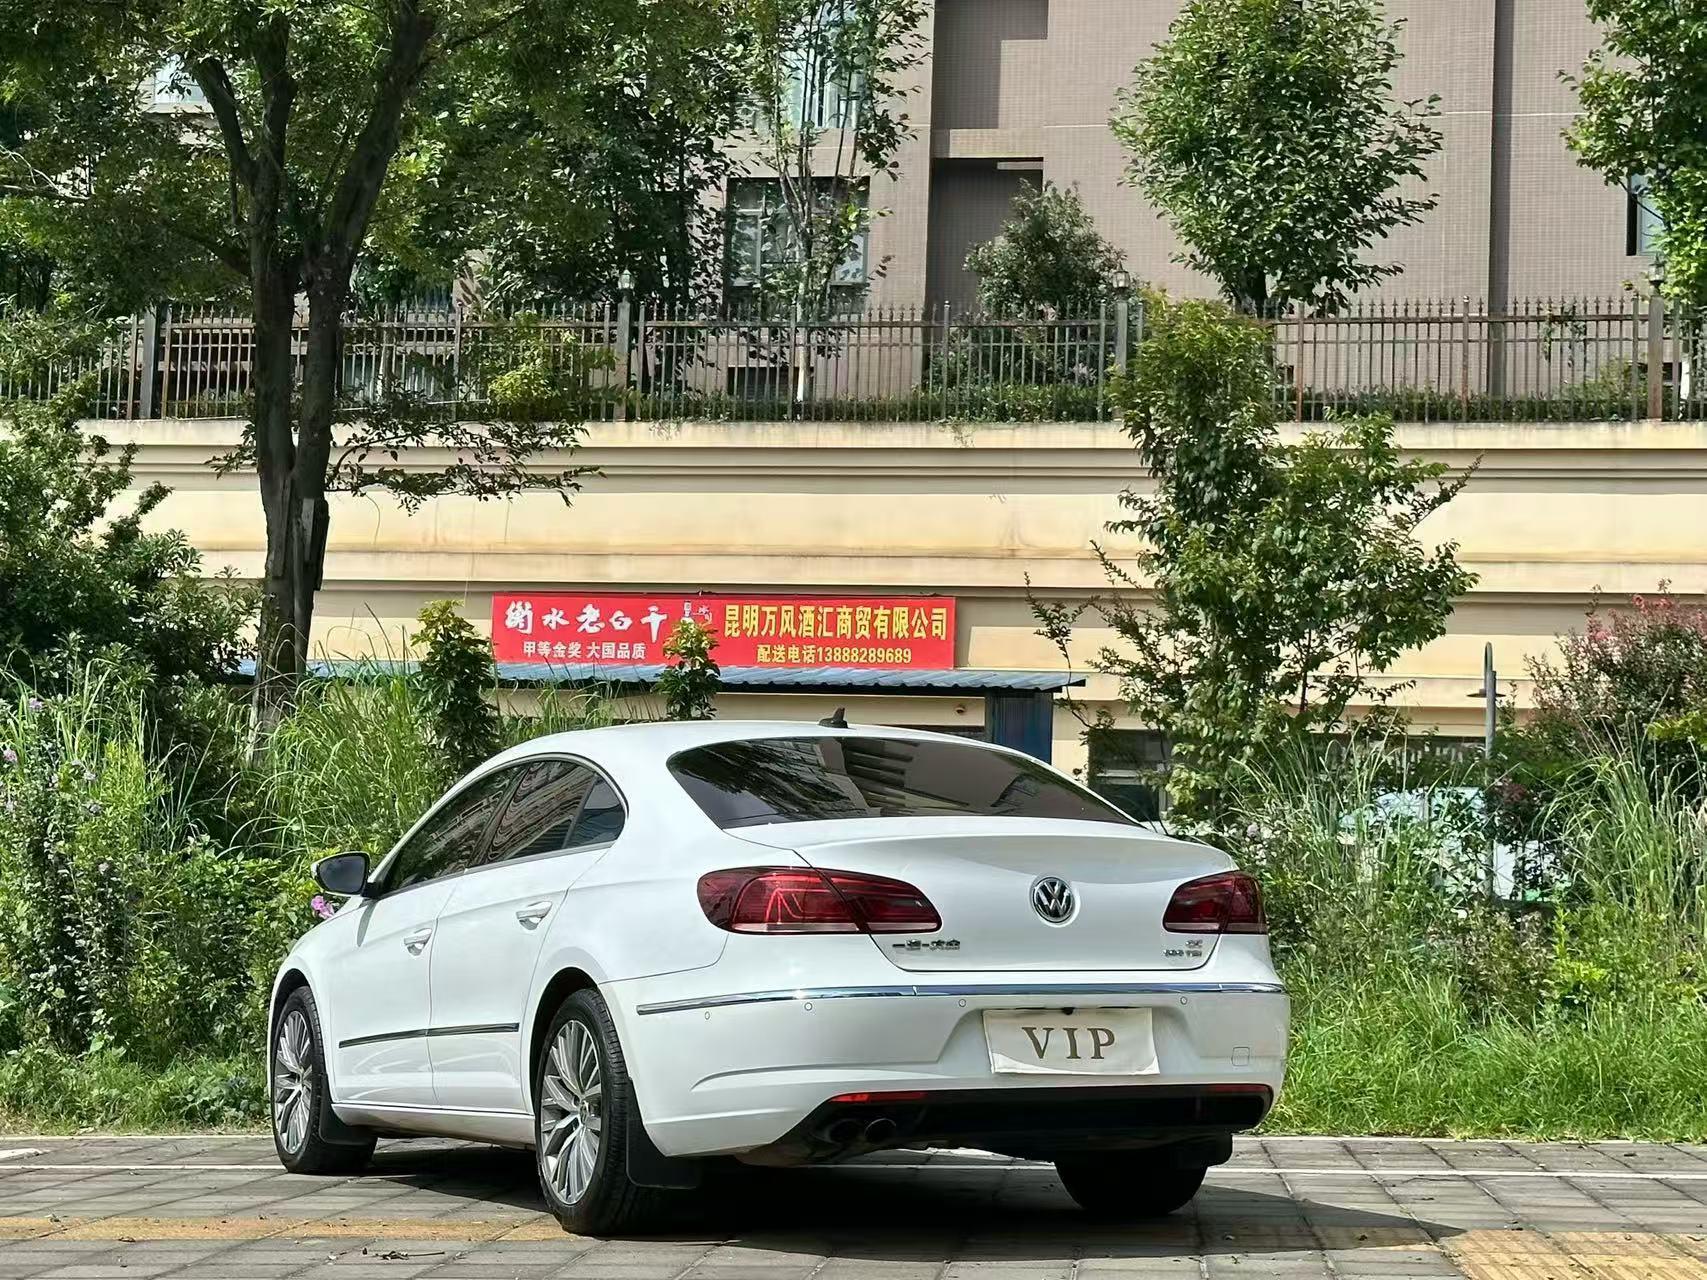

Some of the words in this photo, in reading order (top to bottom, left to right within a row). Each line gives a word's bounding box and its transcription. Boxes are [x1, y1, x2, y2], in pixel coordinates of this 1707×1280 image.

[505, 600, 668, 643] 衡水老白干
[724, 604, 948, 640] 昆明万风酒汇商贸有限公司
[522, 640, 582, 659] 甲等金奖
[586, 641, 647, 660] 大国品质
[756, 644, 912, 664] 配送电话13888289689
[1022, 1026, 1115, 1060] VIP
